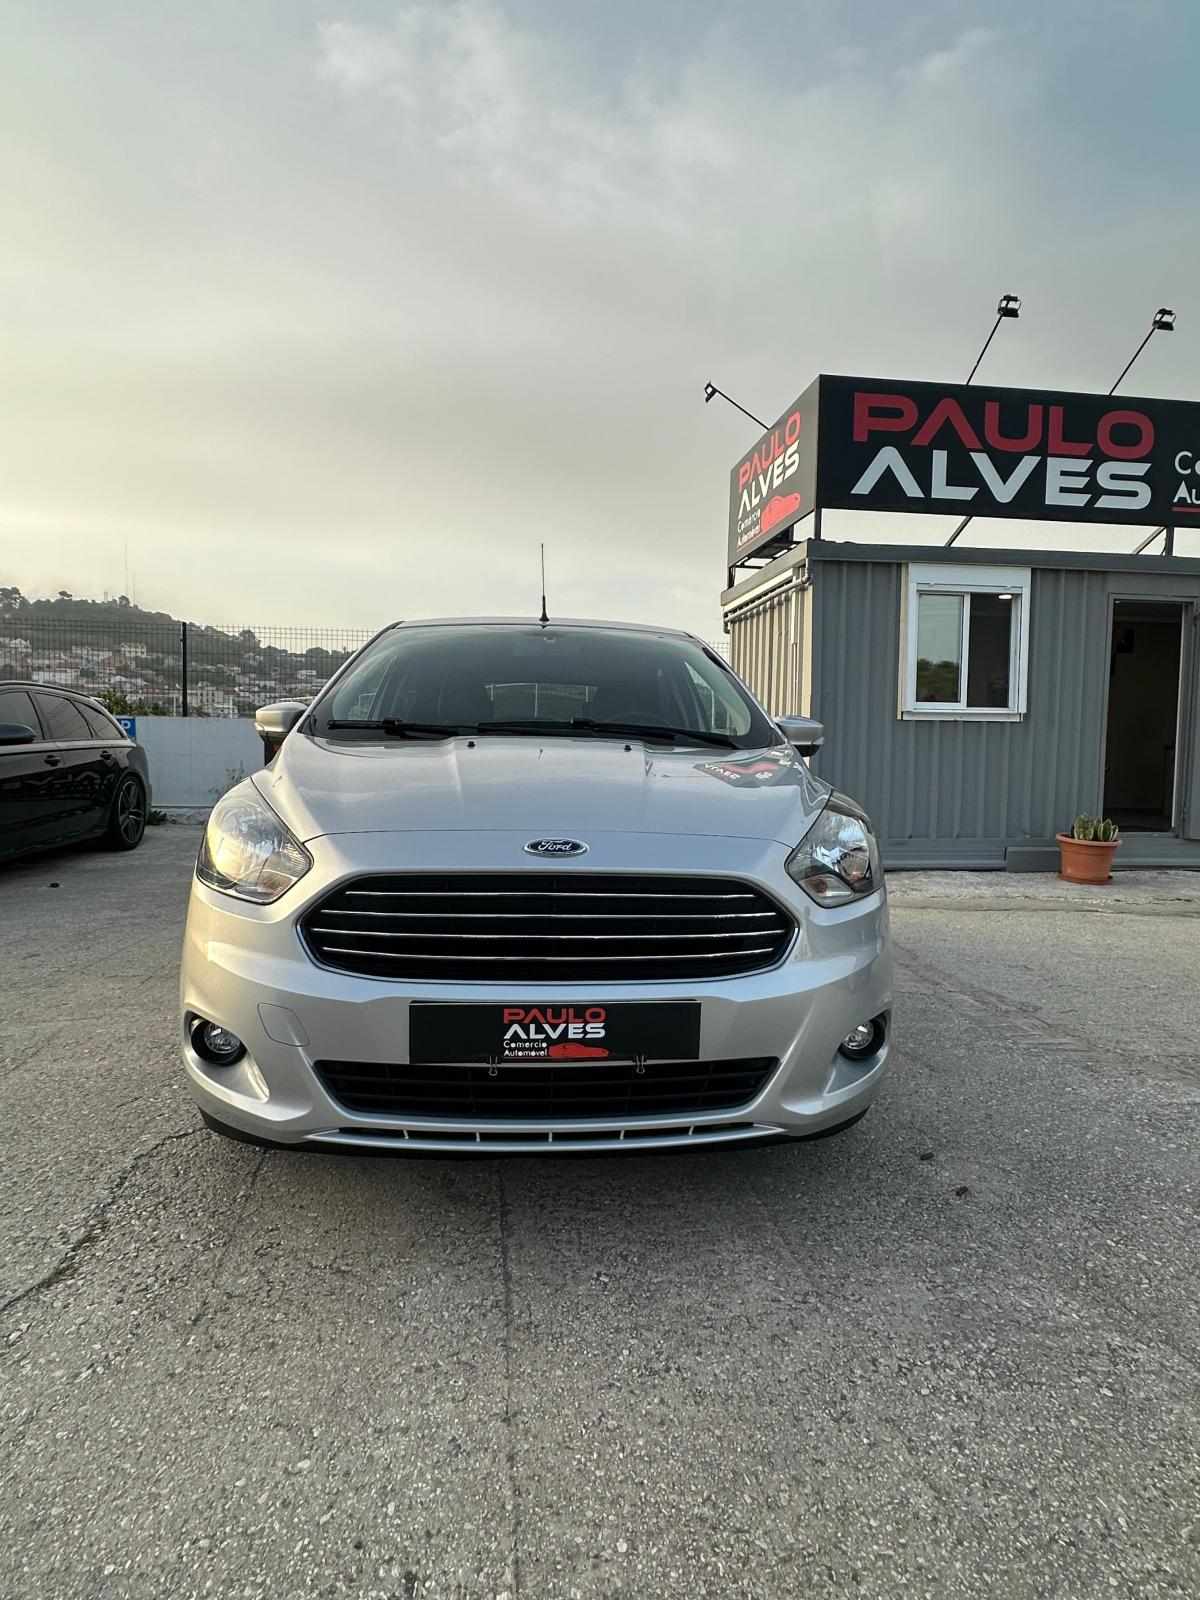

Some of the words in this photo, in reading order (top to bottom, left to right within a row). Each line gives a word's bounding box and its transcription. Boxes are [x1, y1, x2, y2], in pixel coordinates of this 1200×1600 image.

[738, 411, 801, 493] PAULO
[853, 391, 1155, 460] PAULO
[737, 440, 801, 519] ALVES
[850, 446, 1153, 510] ALVES
[538, 840, 573, 851] Ford
[503, 1007, 606, 1024] PAULO
[503, 1022, 606, 1039] ALVES
